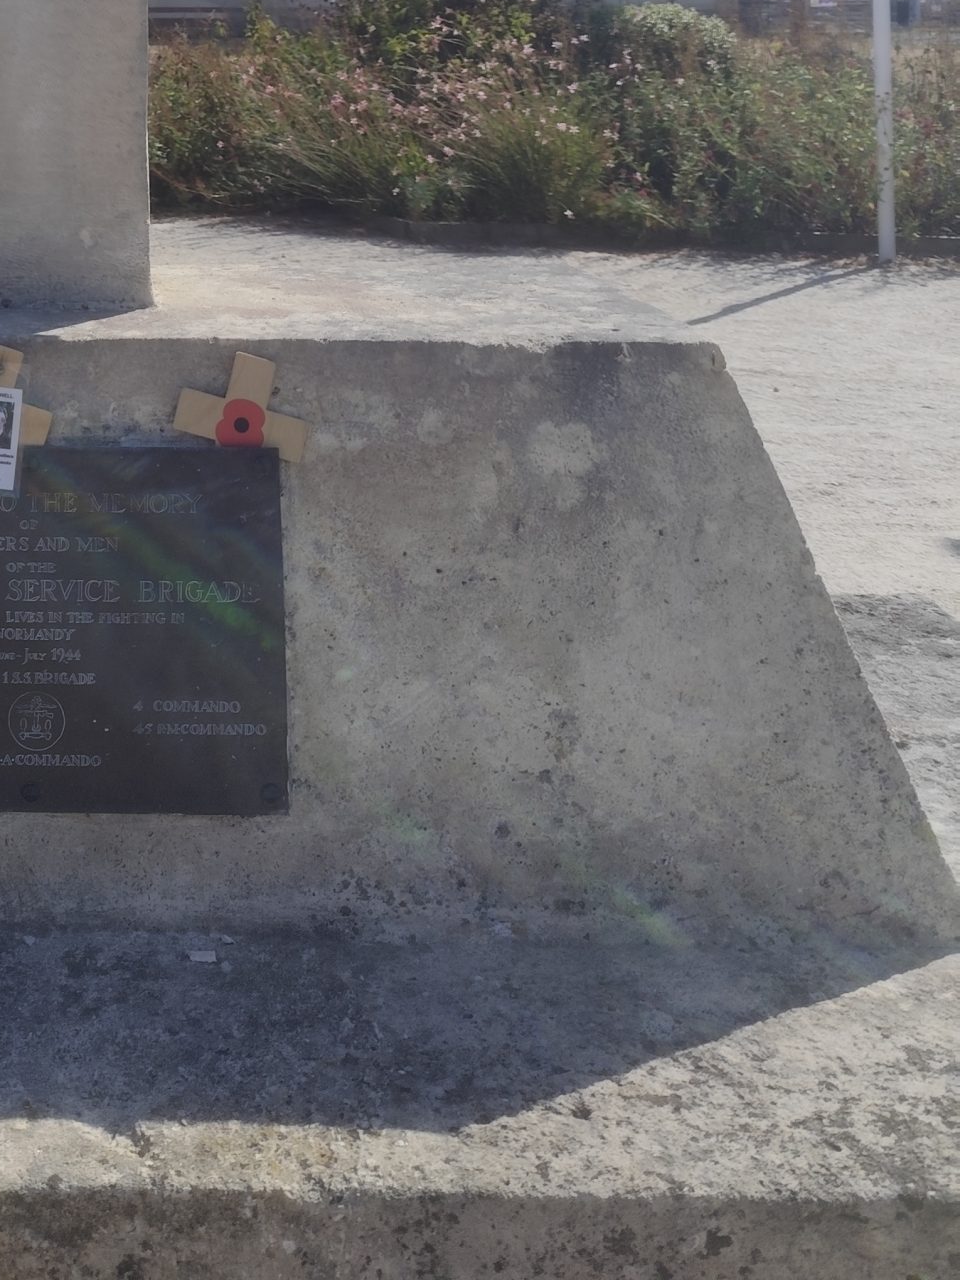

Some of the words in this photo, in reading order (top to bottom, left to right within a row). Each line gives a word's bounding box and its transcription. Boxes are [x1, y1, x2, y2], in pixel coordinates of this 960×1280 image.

[29, 492, 77, 513] THE
[89, 493, 203, 514] MEMORY
[33, 536, 70, 552] AND
[76, 536, 120, 552] MEN
[6, 562, 24, 573] OF
[25, 562, 56, 573] THE
[5, 579, 121, 602] SERVICE
[137, 580, 261, 603] BRIGADE
[6, 611, 43, 622] LIVES
[48, 611, 62, 623] IN
[68, 611, 94, 624] THE
[98, 612, 166, 625] FIGHTING
[171, 612, 185, 624] IN
[51, 648, 81, 662] 1944
[34, 671, 96, 685] BRIGADE
[133, 700, 143, 711] 4
[152, 700, 241, 713] COMMANDO
[133, 723, 153, 735] 45
